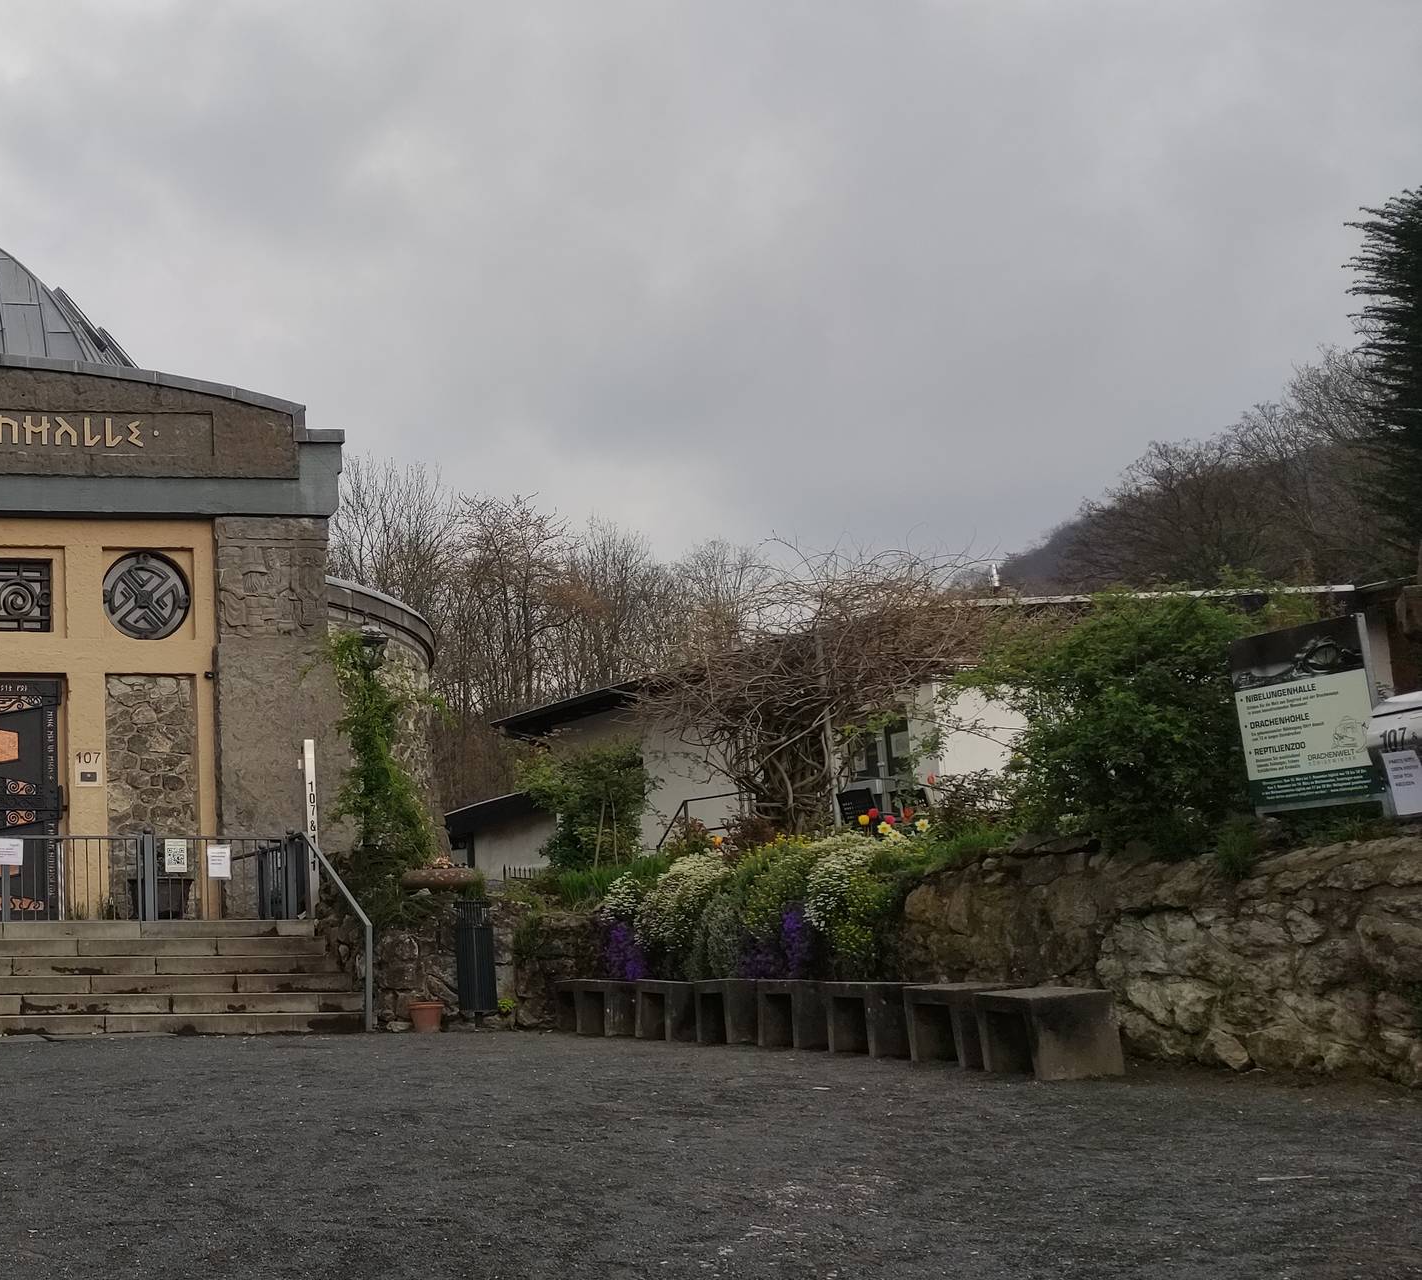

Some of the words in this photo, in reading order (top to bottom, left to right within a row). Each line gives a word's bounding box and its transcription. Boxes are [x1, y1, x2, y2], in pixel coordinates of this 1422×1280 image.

[1245, 683, 1317, 703] NIBELUNGENHALLE
[1379, 727, 1407, 752] 107
[1254, 741, 1306, 756] REPTILIENZOO
[1307, 748, 1355, 761] DRACHENWELT
[75, 751, 101, 764] 107
